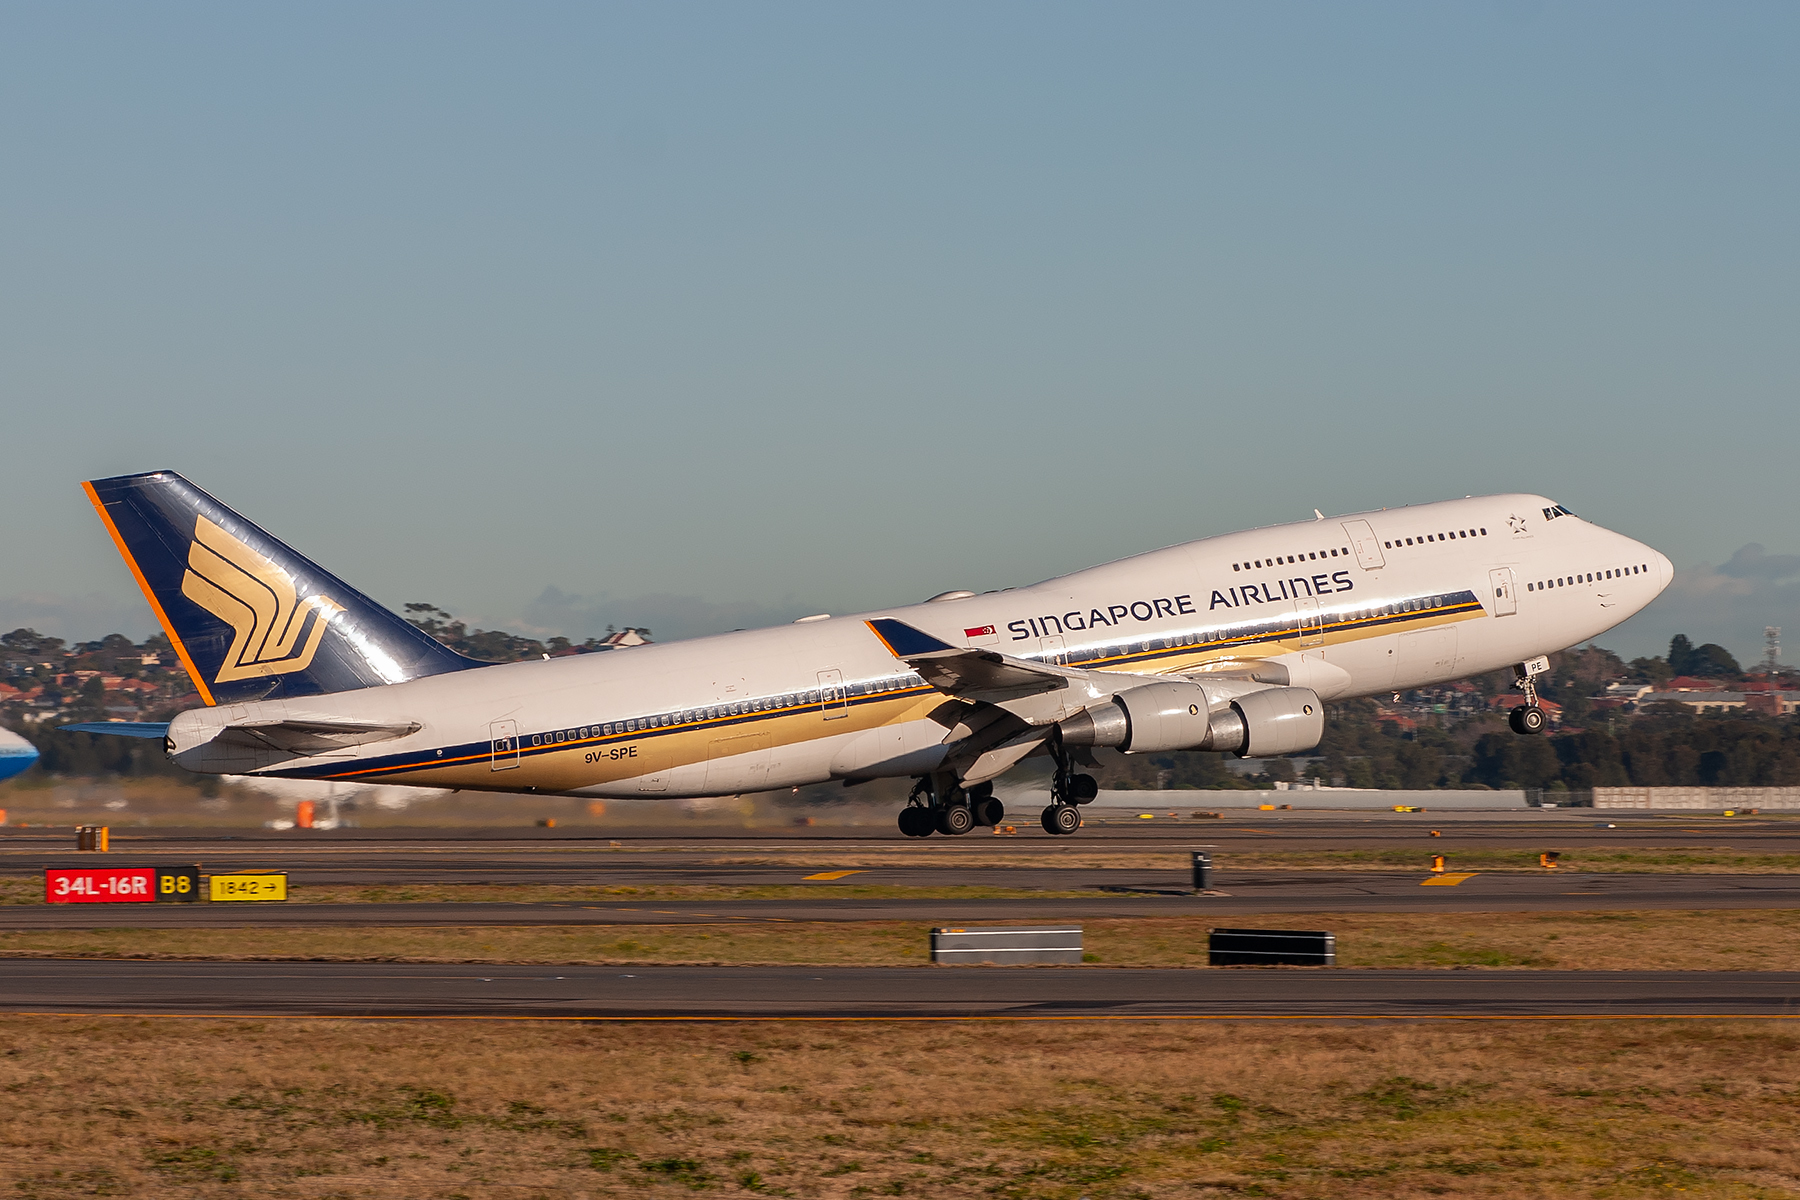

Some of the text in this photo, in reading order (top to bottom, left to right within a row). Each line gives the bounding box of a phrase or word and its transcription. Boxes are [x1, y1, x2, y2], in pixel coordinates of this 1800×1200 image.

[1007, 570, 1354, 641] SINGAPORE AIRLINES
[1531, 661, 1543, 672] PE
[584, 745, 638, 764] 9V-SPE
[54, 876, 148, 895] 34L-16R
[160, 875, 192, 894] B8
[220, 881, 259, 895] 1842
